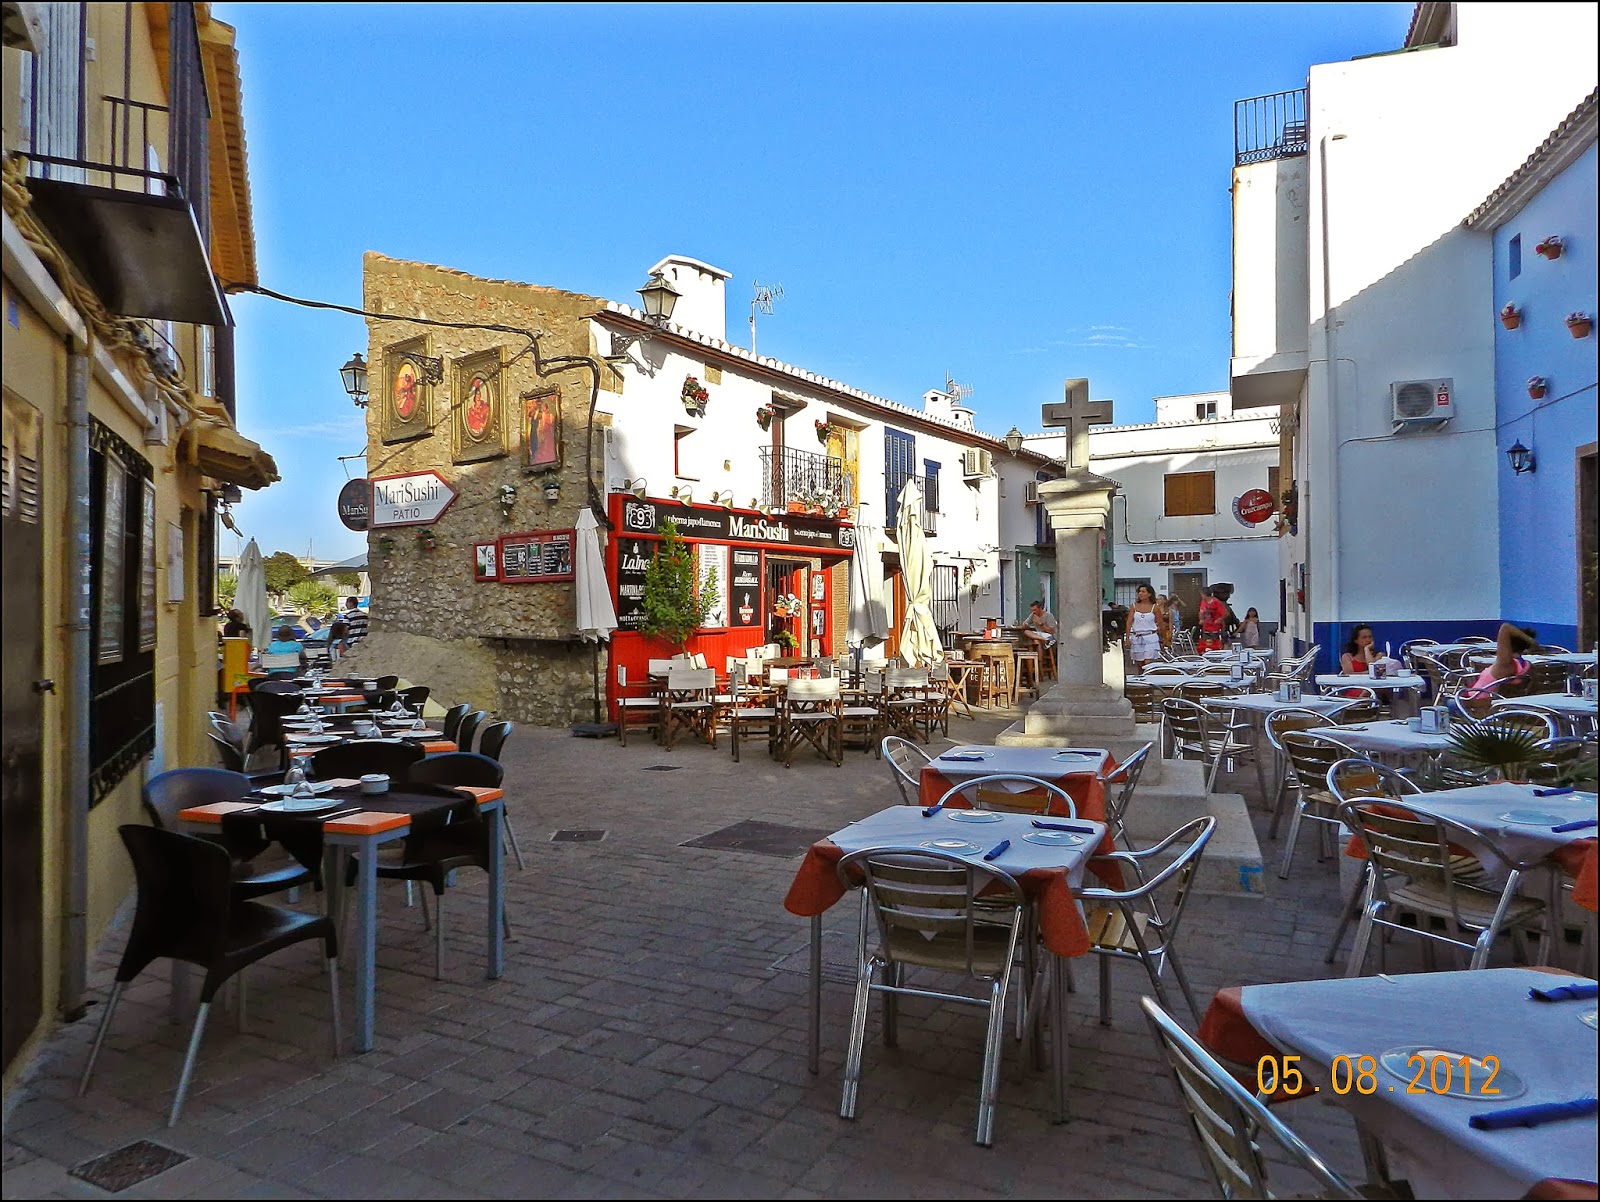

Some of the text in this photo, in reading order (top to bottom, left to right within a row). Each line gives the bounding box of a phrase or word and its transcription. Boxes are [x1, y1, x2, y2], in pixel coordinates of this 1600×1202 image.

[376, 480, 439, 506] MariSushi
[342, 504, 368, 516] MariSu
[393, 507, 421, 520] PATIO
[1241, 502, 1273, 516] Cruzcampo
[636, 509, 646, 526] 9
[728, 515, 790, 542] MariSushi
[1144, 551, 1201, 563] TABACOS
